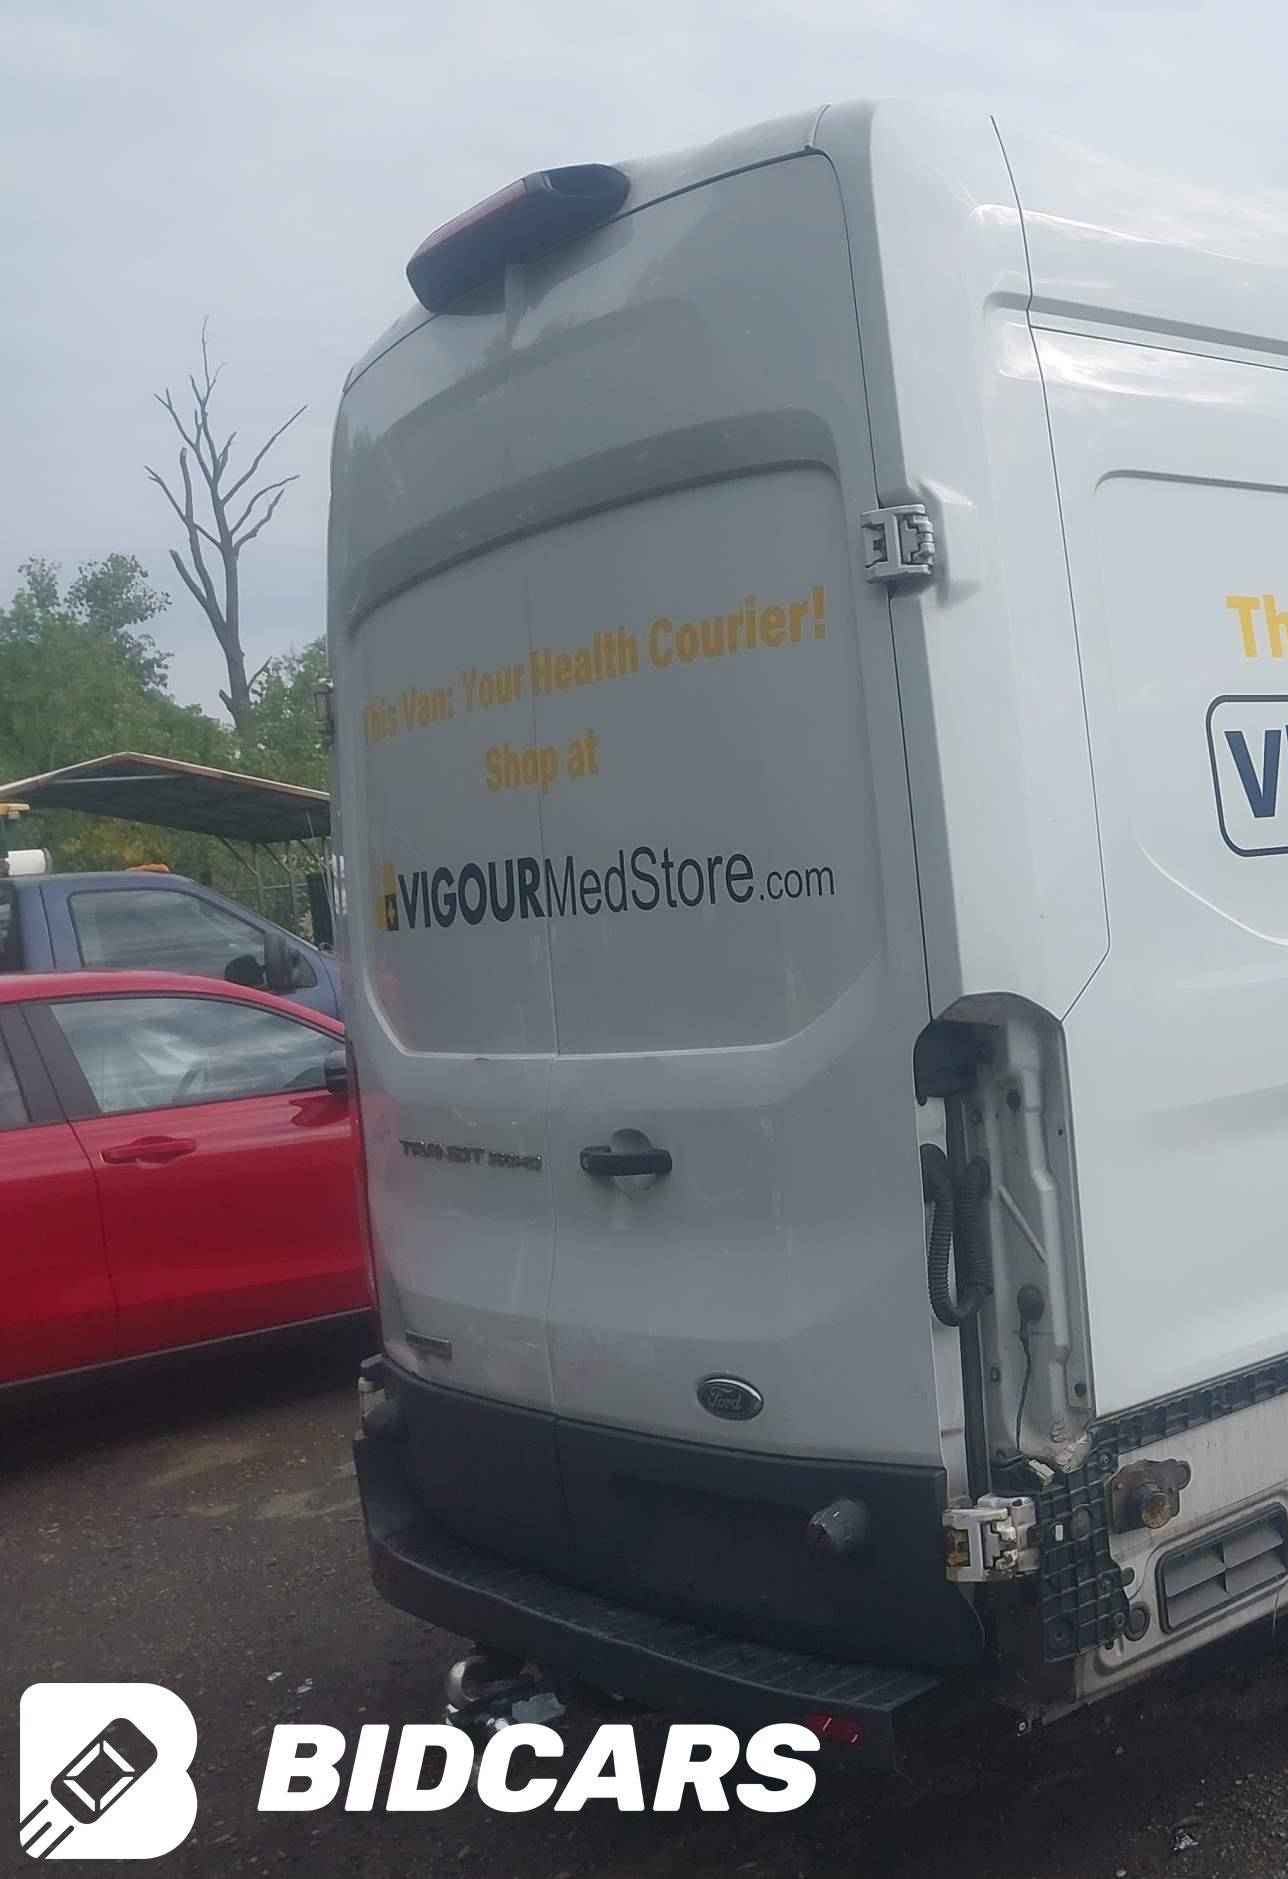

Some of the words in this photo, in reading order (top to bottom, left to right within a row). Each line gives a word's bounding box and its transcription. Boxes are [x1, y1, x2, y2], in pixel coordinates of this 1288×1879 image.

[362, 697, 398, 746] This
[401, 686, 455, 733] Van:
[459, 666, 525, 712] Your
[530, 626, 639, 696] Health
[648, 585, 828, 669] Courier!
[484, 742, 560, 795] Shop
[566, 728, 601, 777] at
[397, 845, 836, 929] VIGOURMedStore.com
[707, 1385, 742, 1412] Ford
